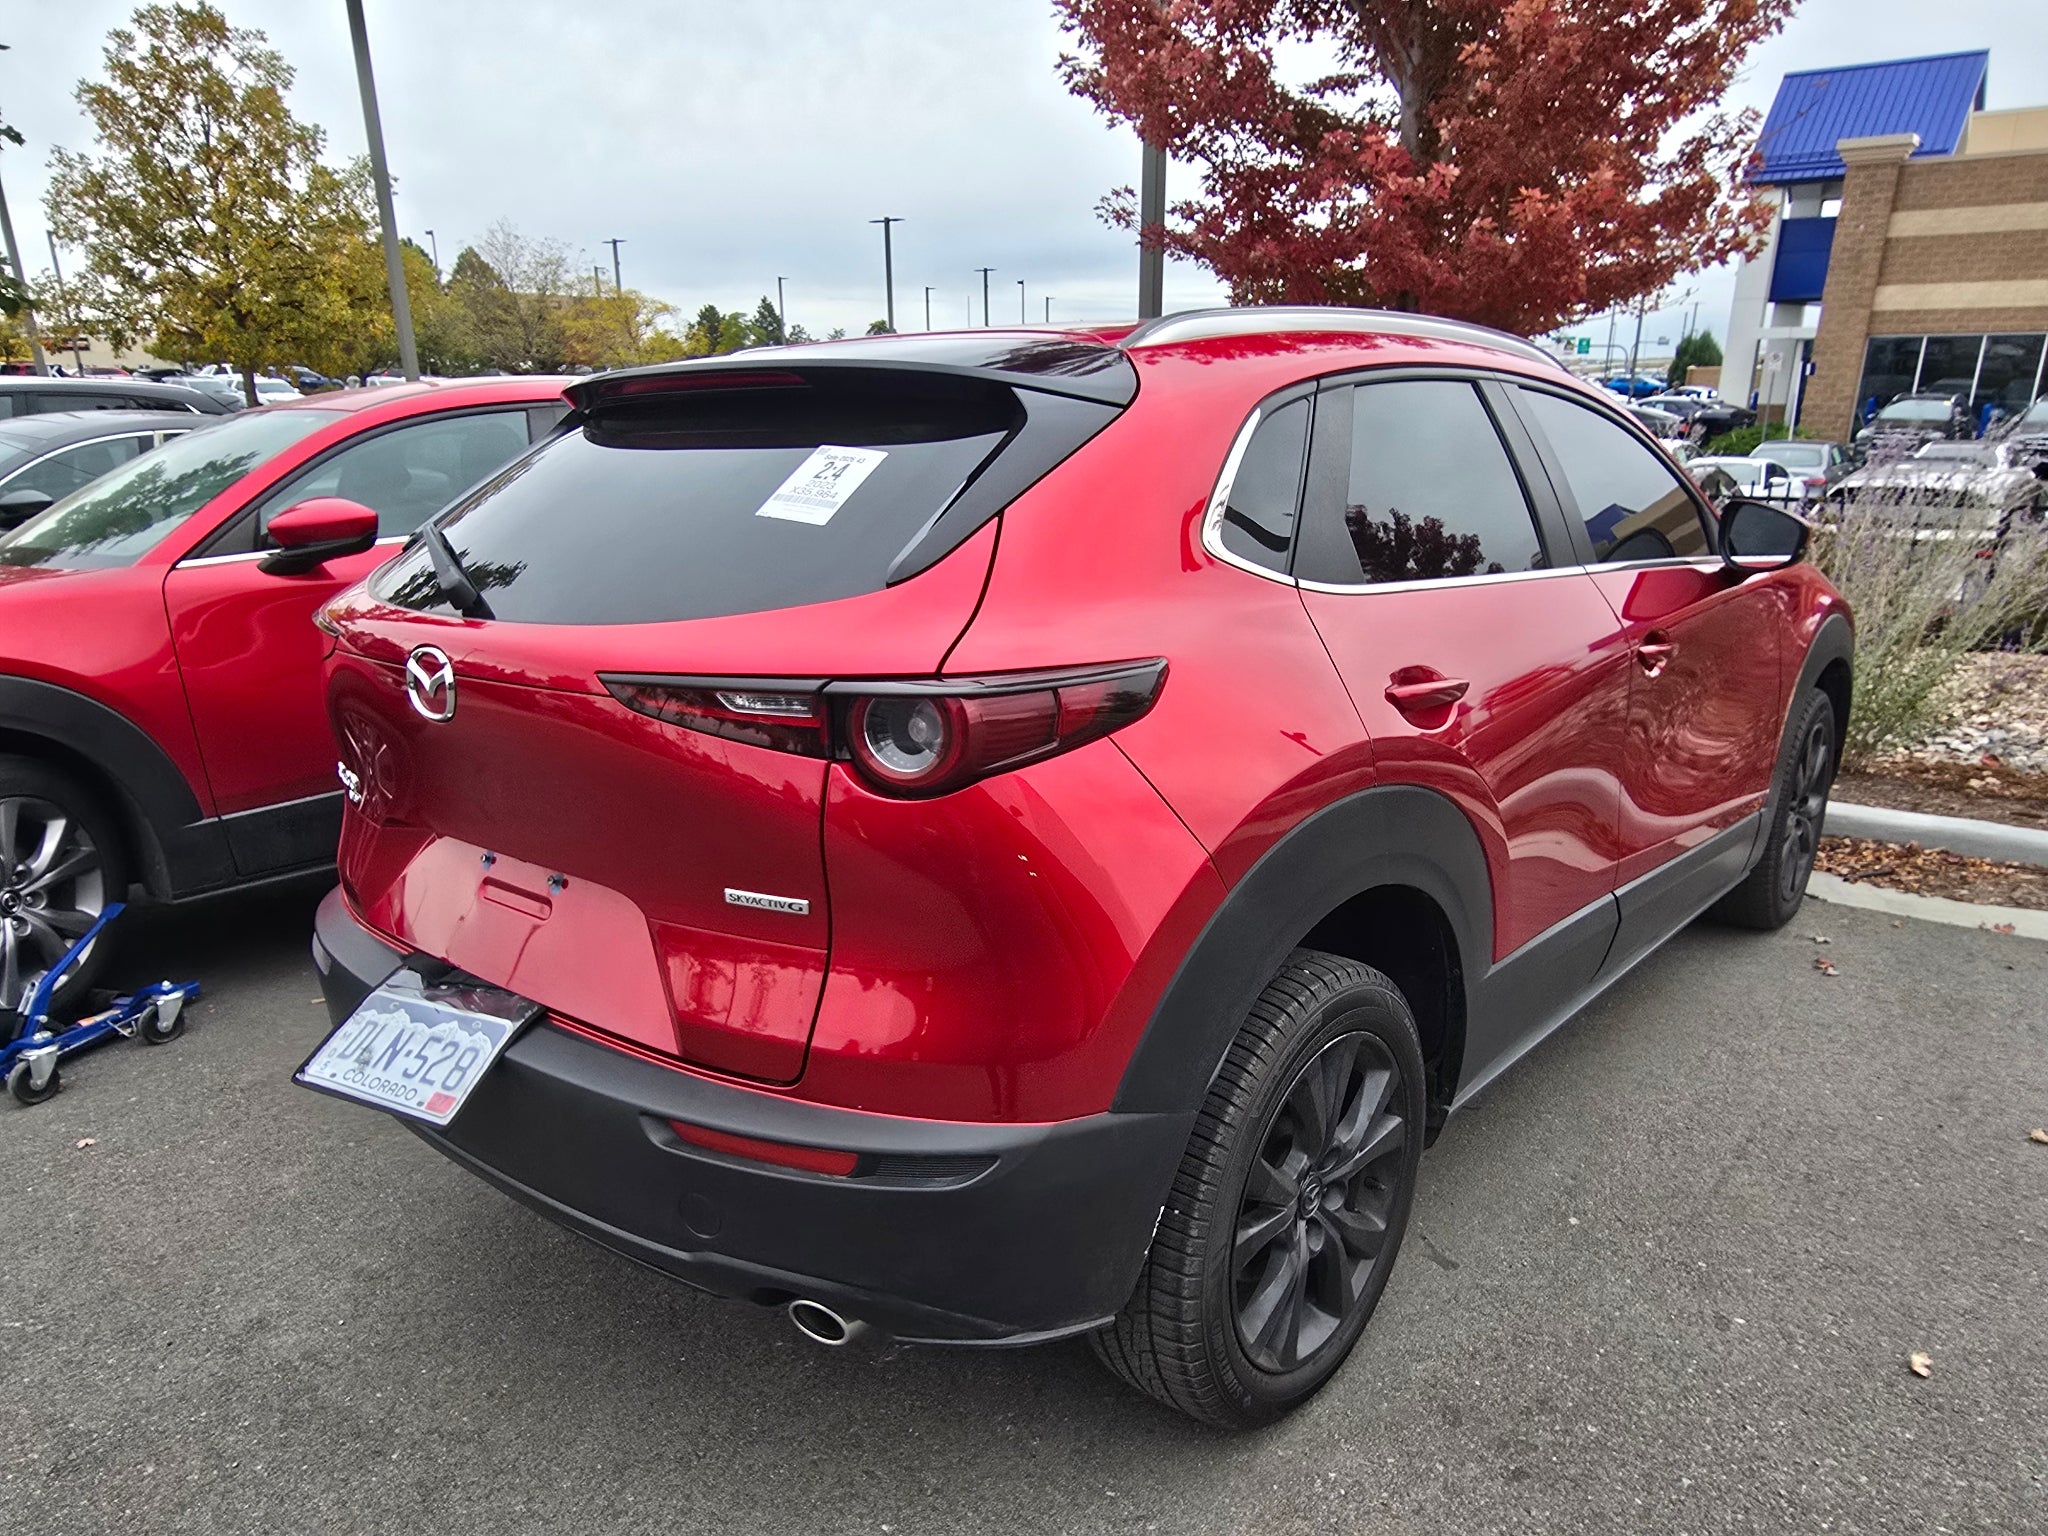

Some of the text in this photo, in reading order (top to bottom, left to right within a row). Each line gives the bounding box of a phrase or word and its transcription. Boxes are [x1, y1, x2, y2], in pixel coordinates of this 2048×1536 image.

[813, 461, 850, 481] 2:4
[805, 479, 837, 490] 2023
[342, 1068, 418, 1101] COLORADO
